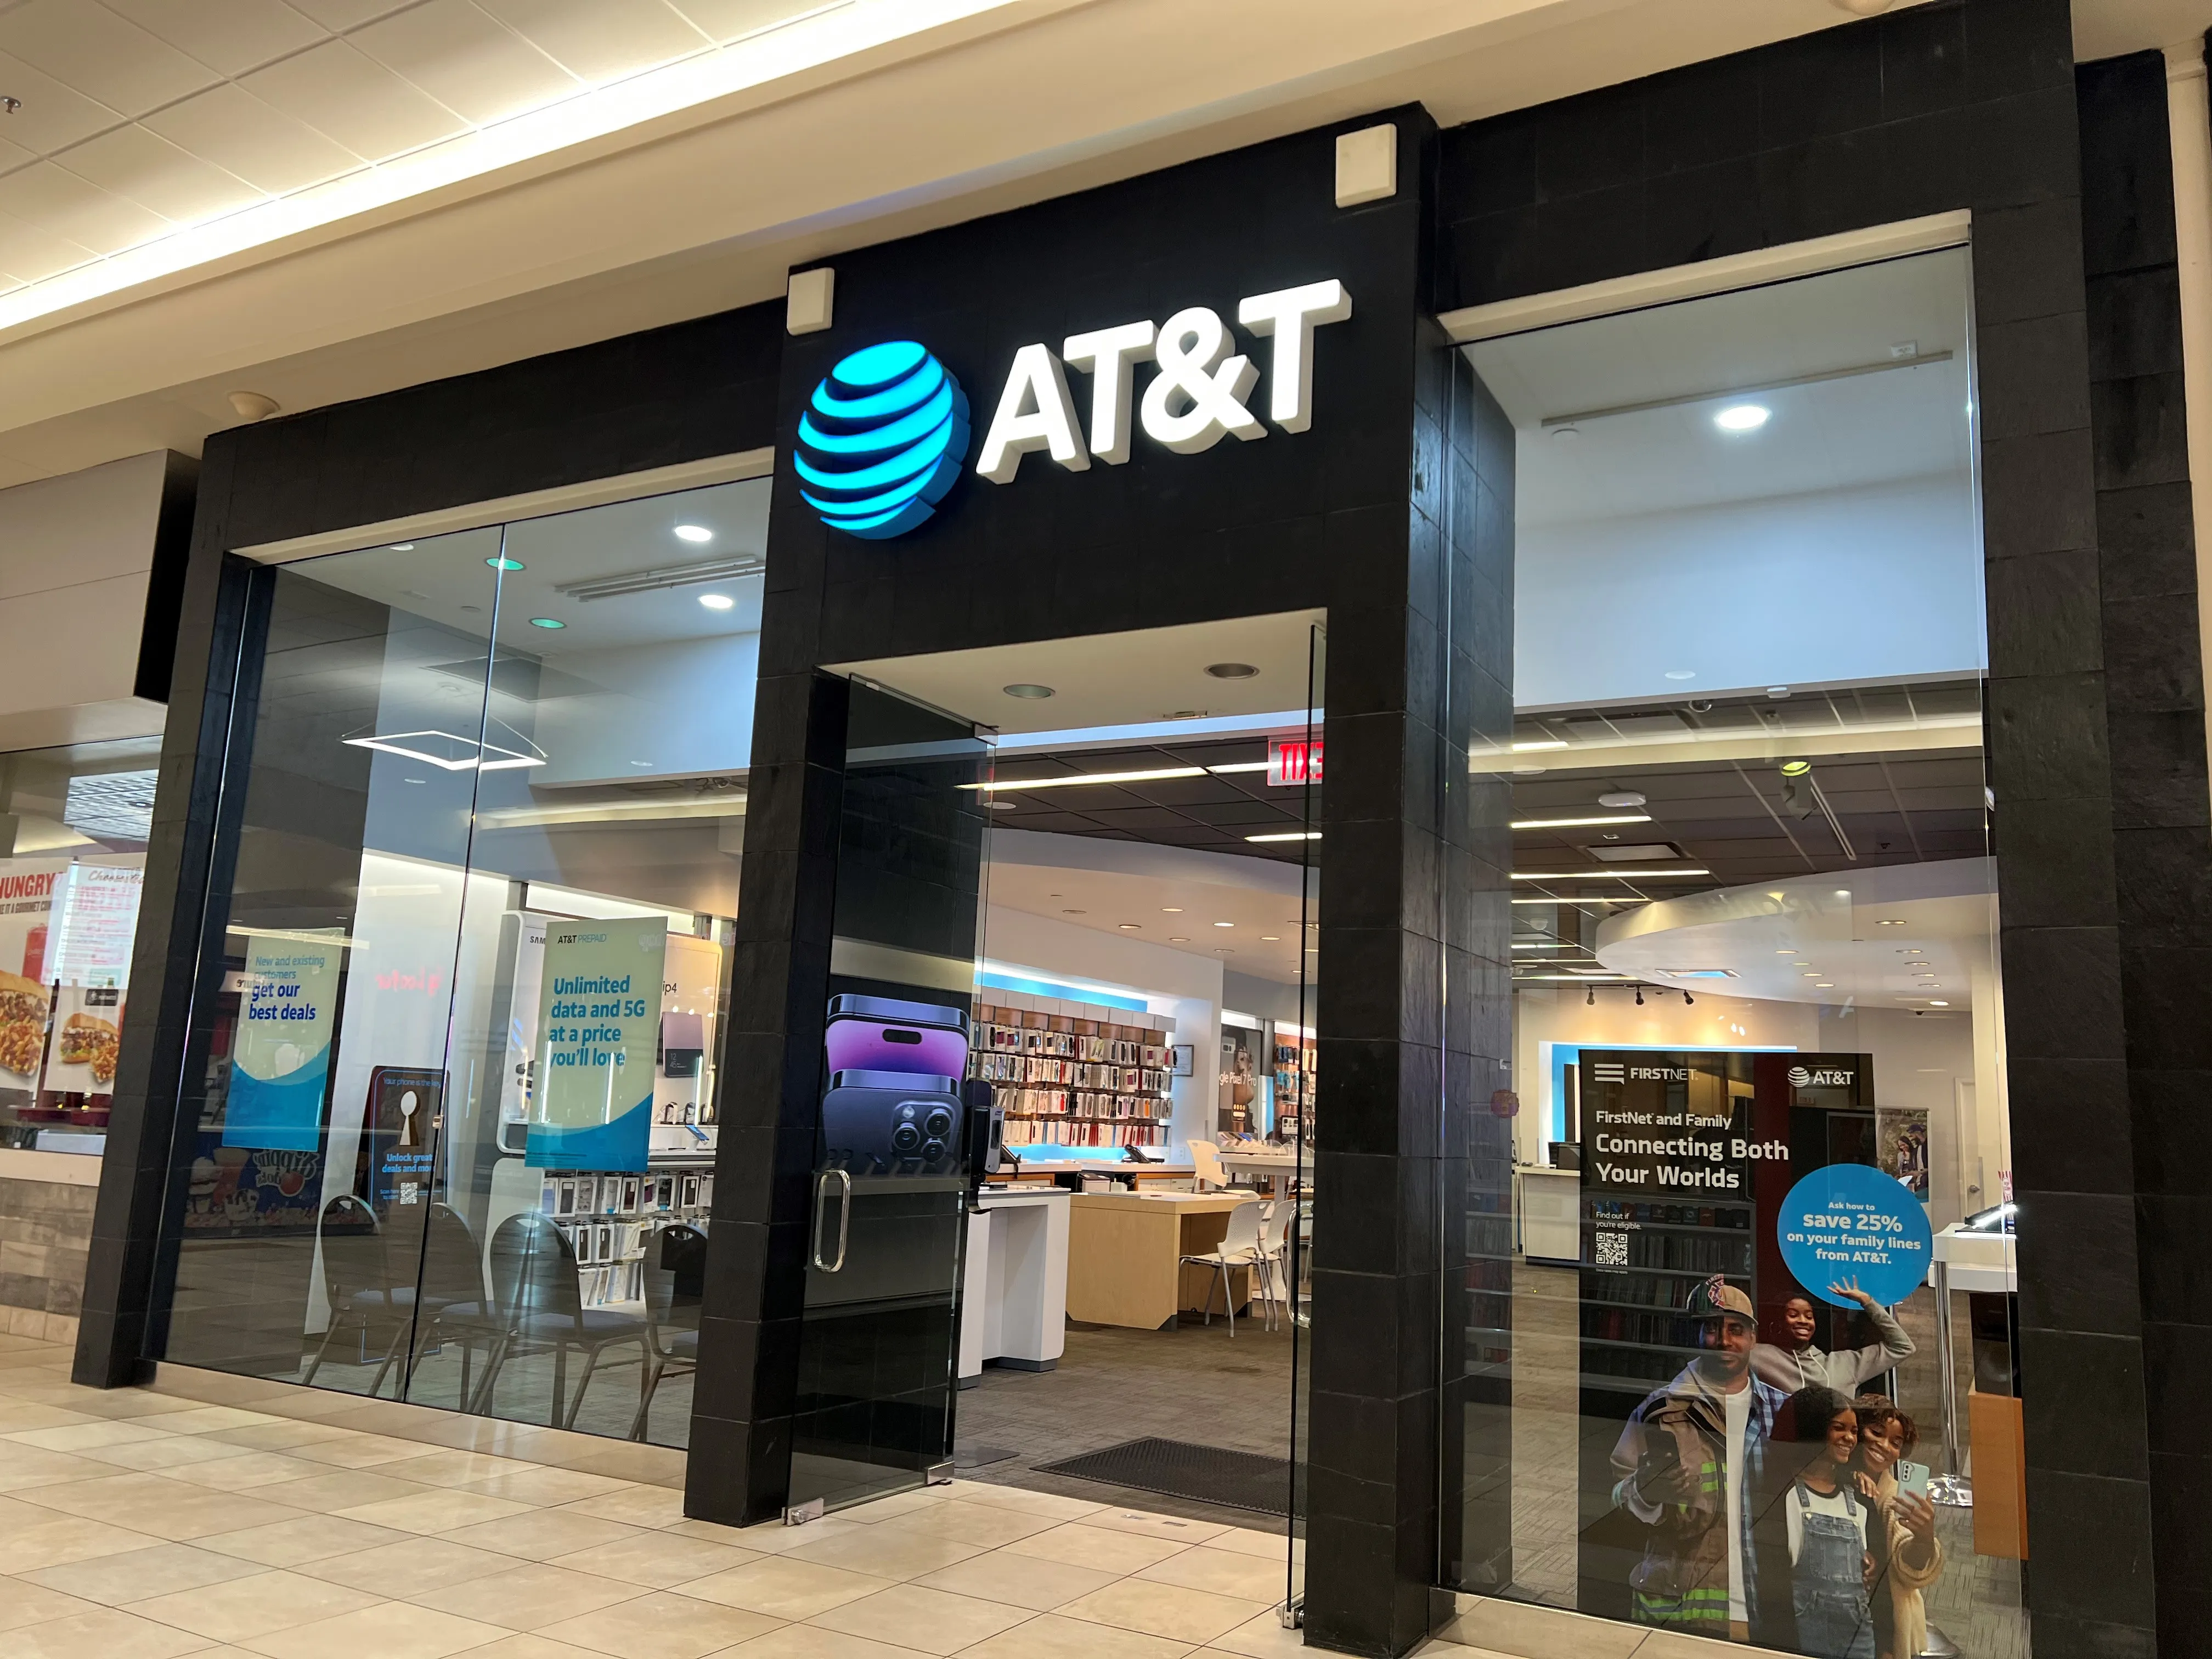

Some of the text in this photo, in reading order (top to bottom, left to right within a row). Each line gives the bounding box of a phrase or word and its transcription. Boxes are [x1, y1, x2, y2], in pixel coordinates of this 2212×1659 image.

[976, 279, 1352, 484] AT&T
[557, 934, 607, 944] AT&T PREPAID
[256, 955, 325, 968] New and existing
[254, 970, 297, 979] customers
[252, 983, 274, 1002] get
[277, 985, 301, 997] our
[555, 975, 630, 995] Unlimited
[249, 1003, 316, 1020] best deals
[551, 1000, 645, 1018] data and 5G
[549, 1024, 621, 1047] at a price
[592, 1048, 625, 1066] love
[1219, 1071, 1257, 1087] gle Pixel 7 Pro
[1630, 1068, 1697, 1080] FIRSTNET
[1813, 1071, 1854, 1085] AT&T
[1596, 1110, 1732, 1130] FirstNet and Family
[1596, 1133, 1789, 1161] Connecting Both
[387, 1153, 433, 1163] Unlock great
[382, 1164, 402, 1173] deals
[403, 1163, 416, 1172] and
[1595, 1163, 1739, 1188] Your Worlds
[1617, 1222, 1641, 1231] eligible.
[1803, 1214, 1903, 1232] save 25%
[1787, 1233, 1921, 1250] on your family lines
[1815, 1248, 1892, 1265] from AT&T.
